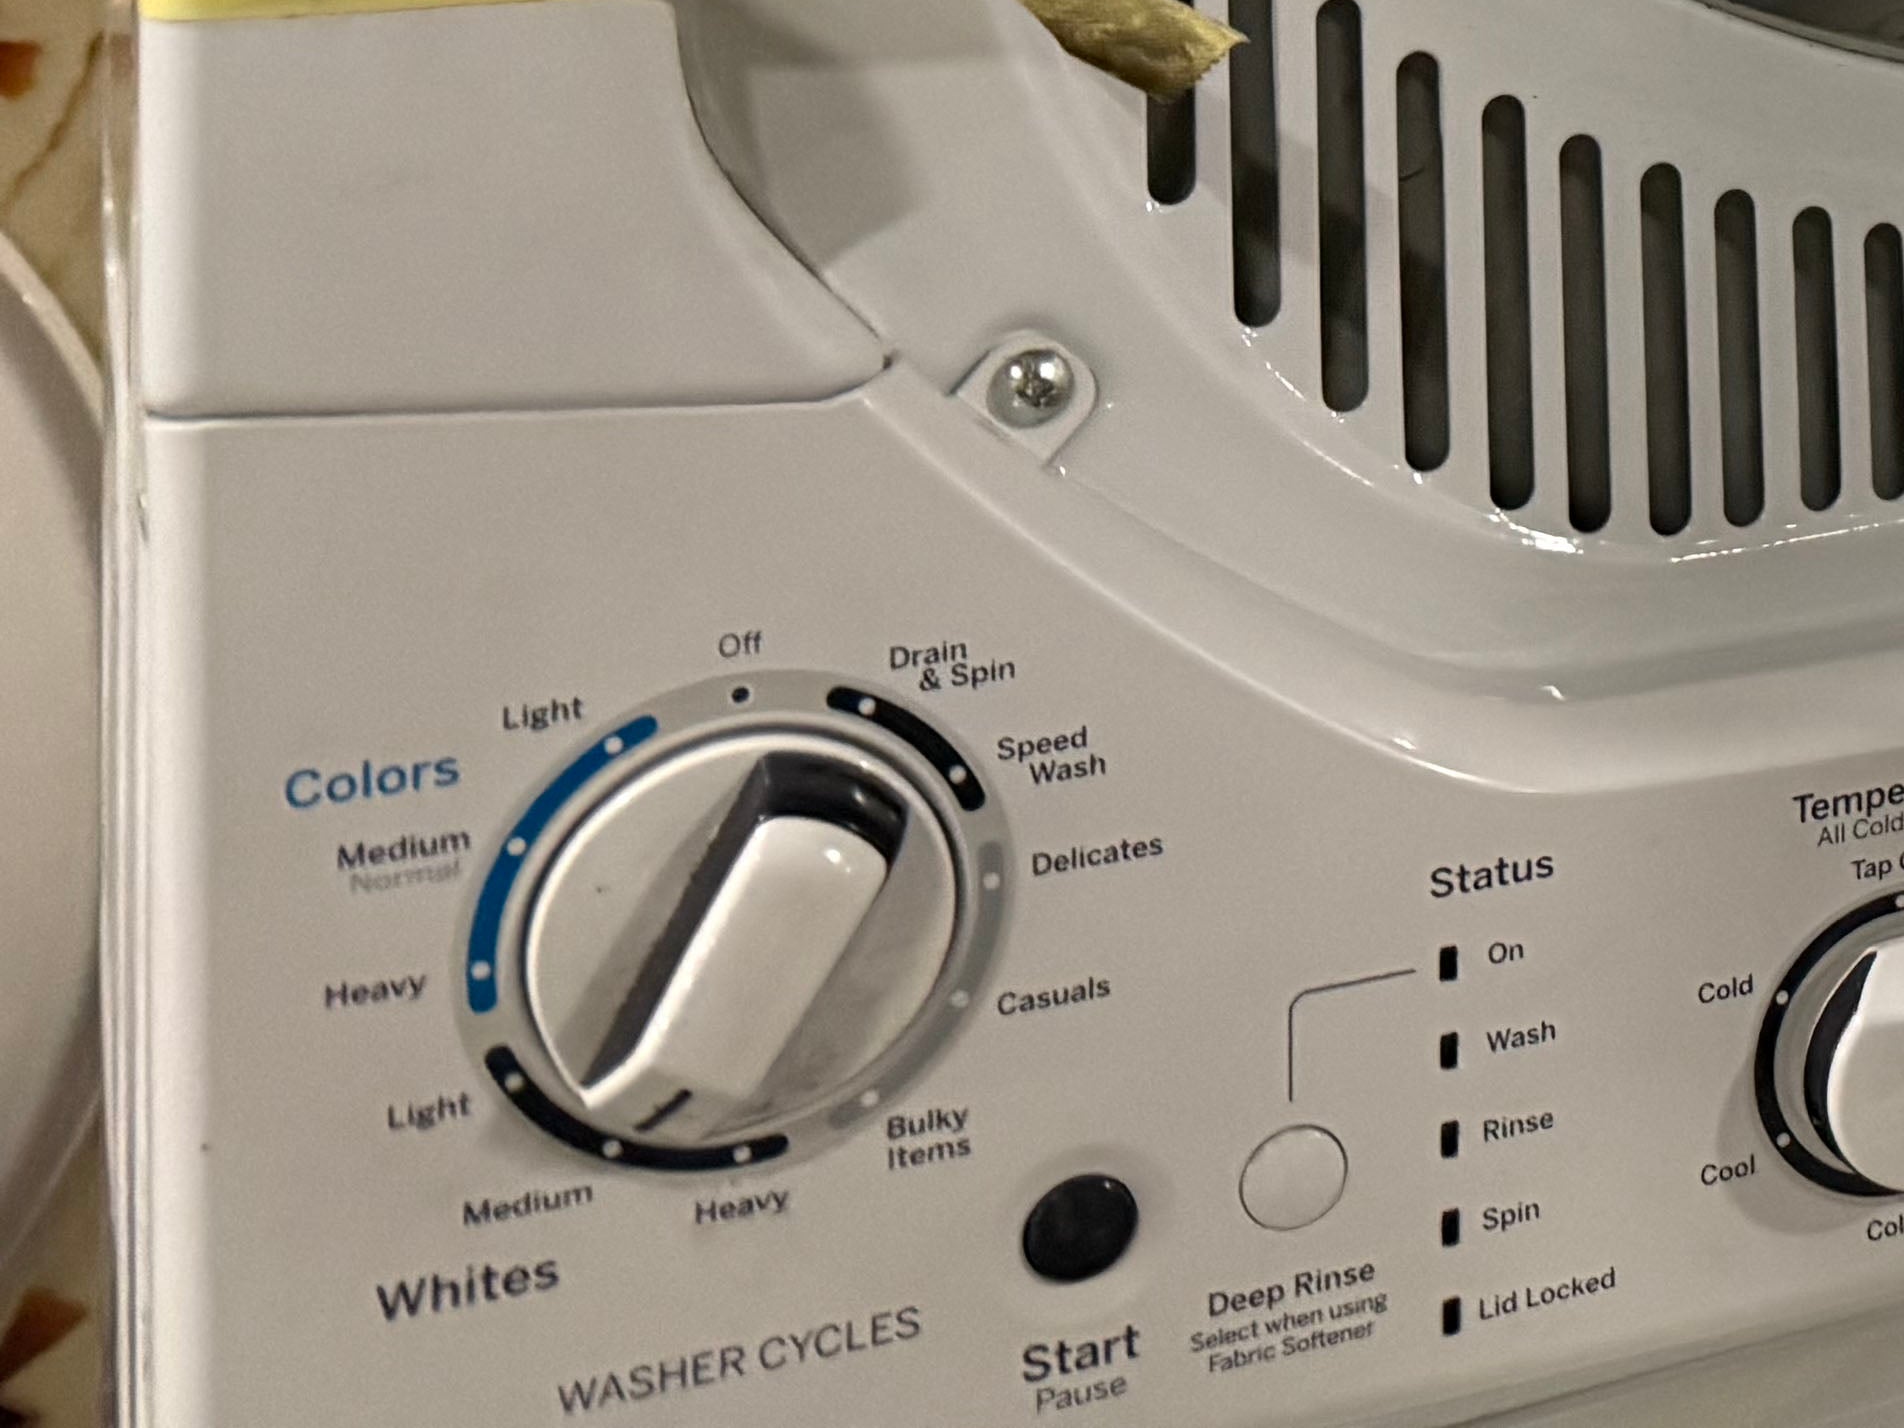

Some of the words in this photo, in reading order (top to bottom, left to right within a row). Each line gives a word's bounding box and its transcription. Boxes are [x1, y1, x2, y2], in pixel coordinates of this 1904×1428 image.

[716, 630, 768, 659] Off
[889, 640, 968, 671] Drain
[919, 667, 941, 692] &
[951, 659, 1016, 690] Spin
[502, 696, 583, 733] Light
[997, 725, 1088, 764] Speed
[284, 756, 460, 809] Colors
[1029, 753, 1106, 786] Wash
[1816, 822, 1846, 848] All
[1852, 810, 1904, 840] Cold
[337, 831, 471, 870] Medium
[1032, 837, 1164, 877] Delicates
[1850, 858, 1893, 881] Tap
[349, 856, 462, 894] Normal
[1430, 855, 1554, 899] Status
[1487, 941, 1524, 965] On
[324, 975, 427, 1009] Heavy
[997, 976, 1111, 1016] Casuals
[1697, 973, 1754, 1004] Cold
[1486, 1020, 1556, 1053] Wash
[387, 1091, 470, 1131] Light
[884, 1104, 969, 1141] Bulky
[1483, 1112, 1554, 1143] Rinse
[887, 1138, 972, 1171] Items
[1700, 1153, 1756, 1186] Cool
[462, 1185, 593, 1227] Medium
[695, 1190, 789, 1225] Heavy
[1482, 1202, 1540, 1233] Spin
[376, 1260, 560, 1322] Whites
[1208, 1284, 1286, 1318] Deep
[1294, 1263, 1376, 1298] Rinse
[1479, 1290, 1518, 1321] Lid
[1525, 1266, 1616, 1308] Locked
[1190, 1319, 1259, 1354] Select
[1264, 1308, 1324, 1335] when
[1328, 1292, 1388, 1321] using
[557, 1345, 746, 1415] WASHER
[758, 1305, 922, 1372] CYCLES
[1022, 1324, 1140, 1383] Start
[1208, 1345, 1276, 1374] Fabric
[1281, 1321, 1374, 1357] Softener
[1036, 1376, 1127, 1415] Pause
